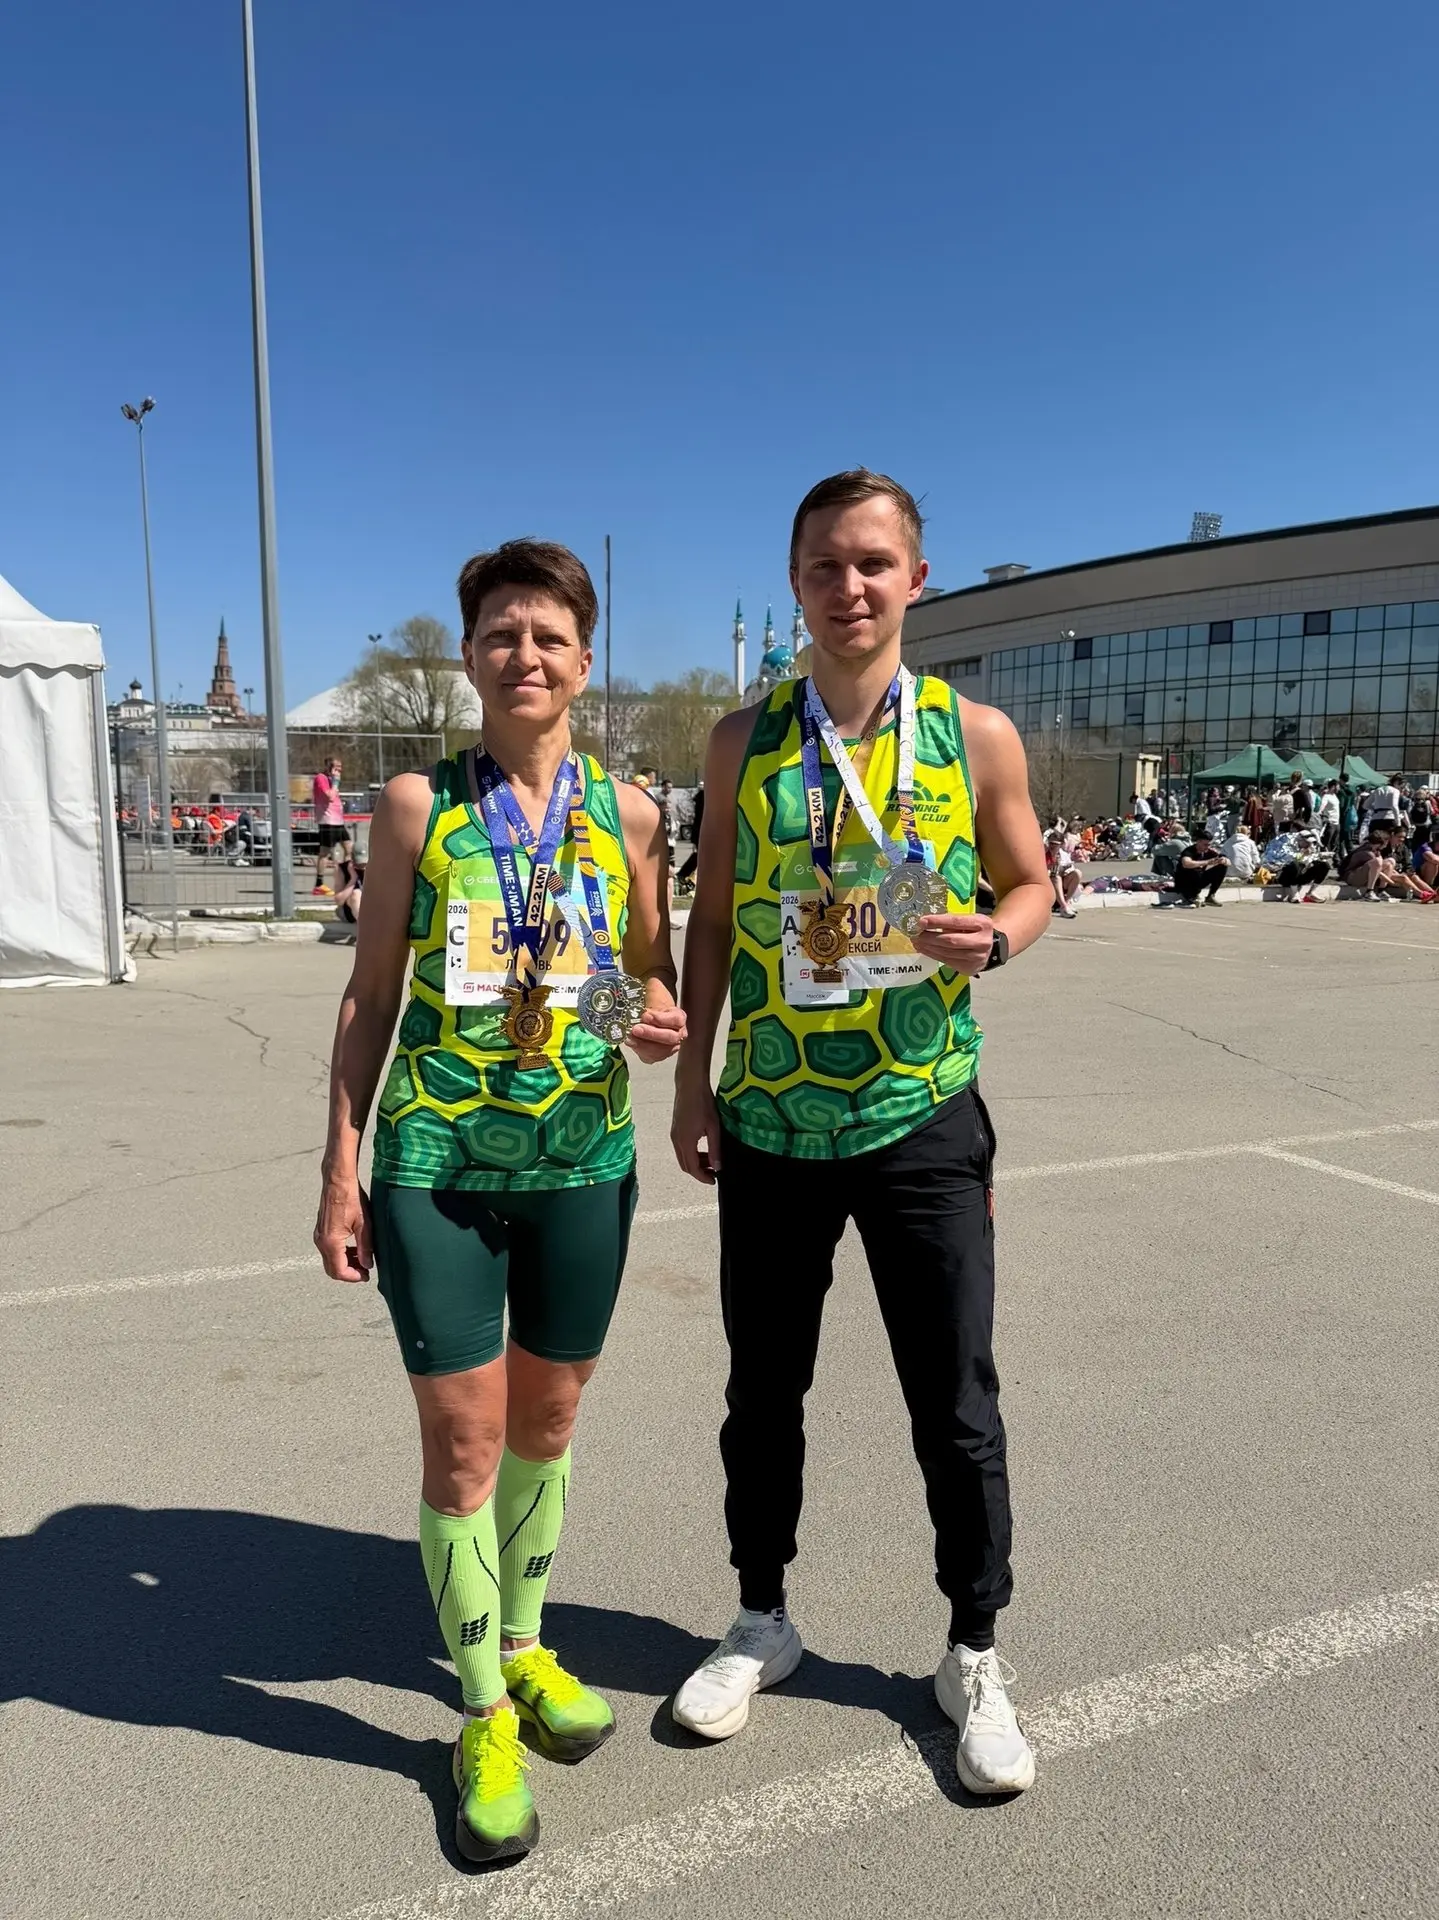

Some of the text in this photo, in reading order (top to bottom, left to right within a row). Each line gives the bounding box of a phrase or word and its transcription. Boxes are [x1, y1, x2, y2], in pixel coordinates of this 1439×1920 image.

[886, 803, 940, 813] RNING
[811, 791, 825, 843] 42.2 KM
[921, 813, 951, 823] CLUB
[476, 876, 499, 884] СБЕ
[530, 868, 547, 922] 42.2 KM
[781, 896, 799, 904] 2026
[448, 905, 468, 914] 2026
[491, 917, 571, 956] 599
[848, 939, 882, 953] ЕКСЕЙ
[523, 1568, 548, 1578] cep
[460, 1632, 486, 1646] cep
